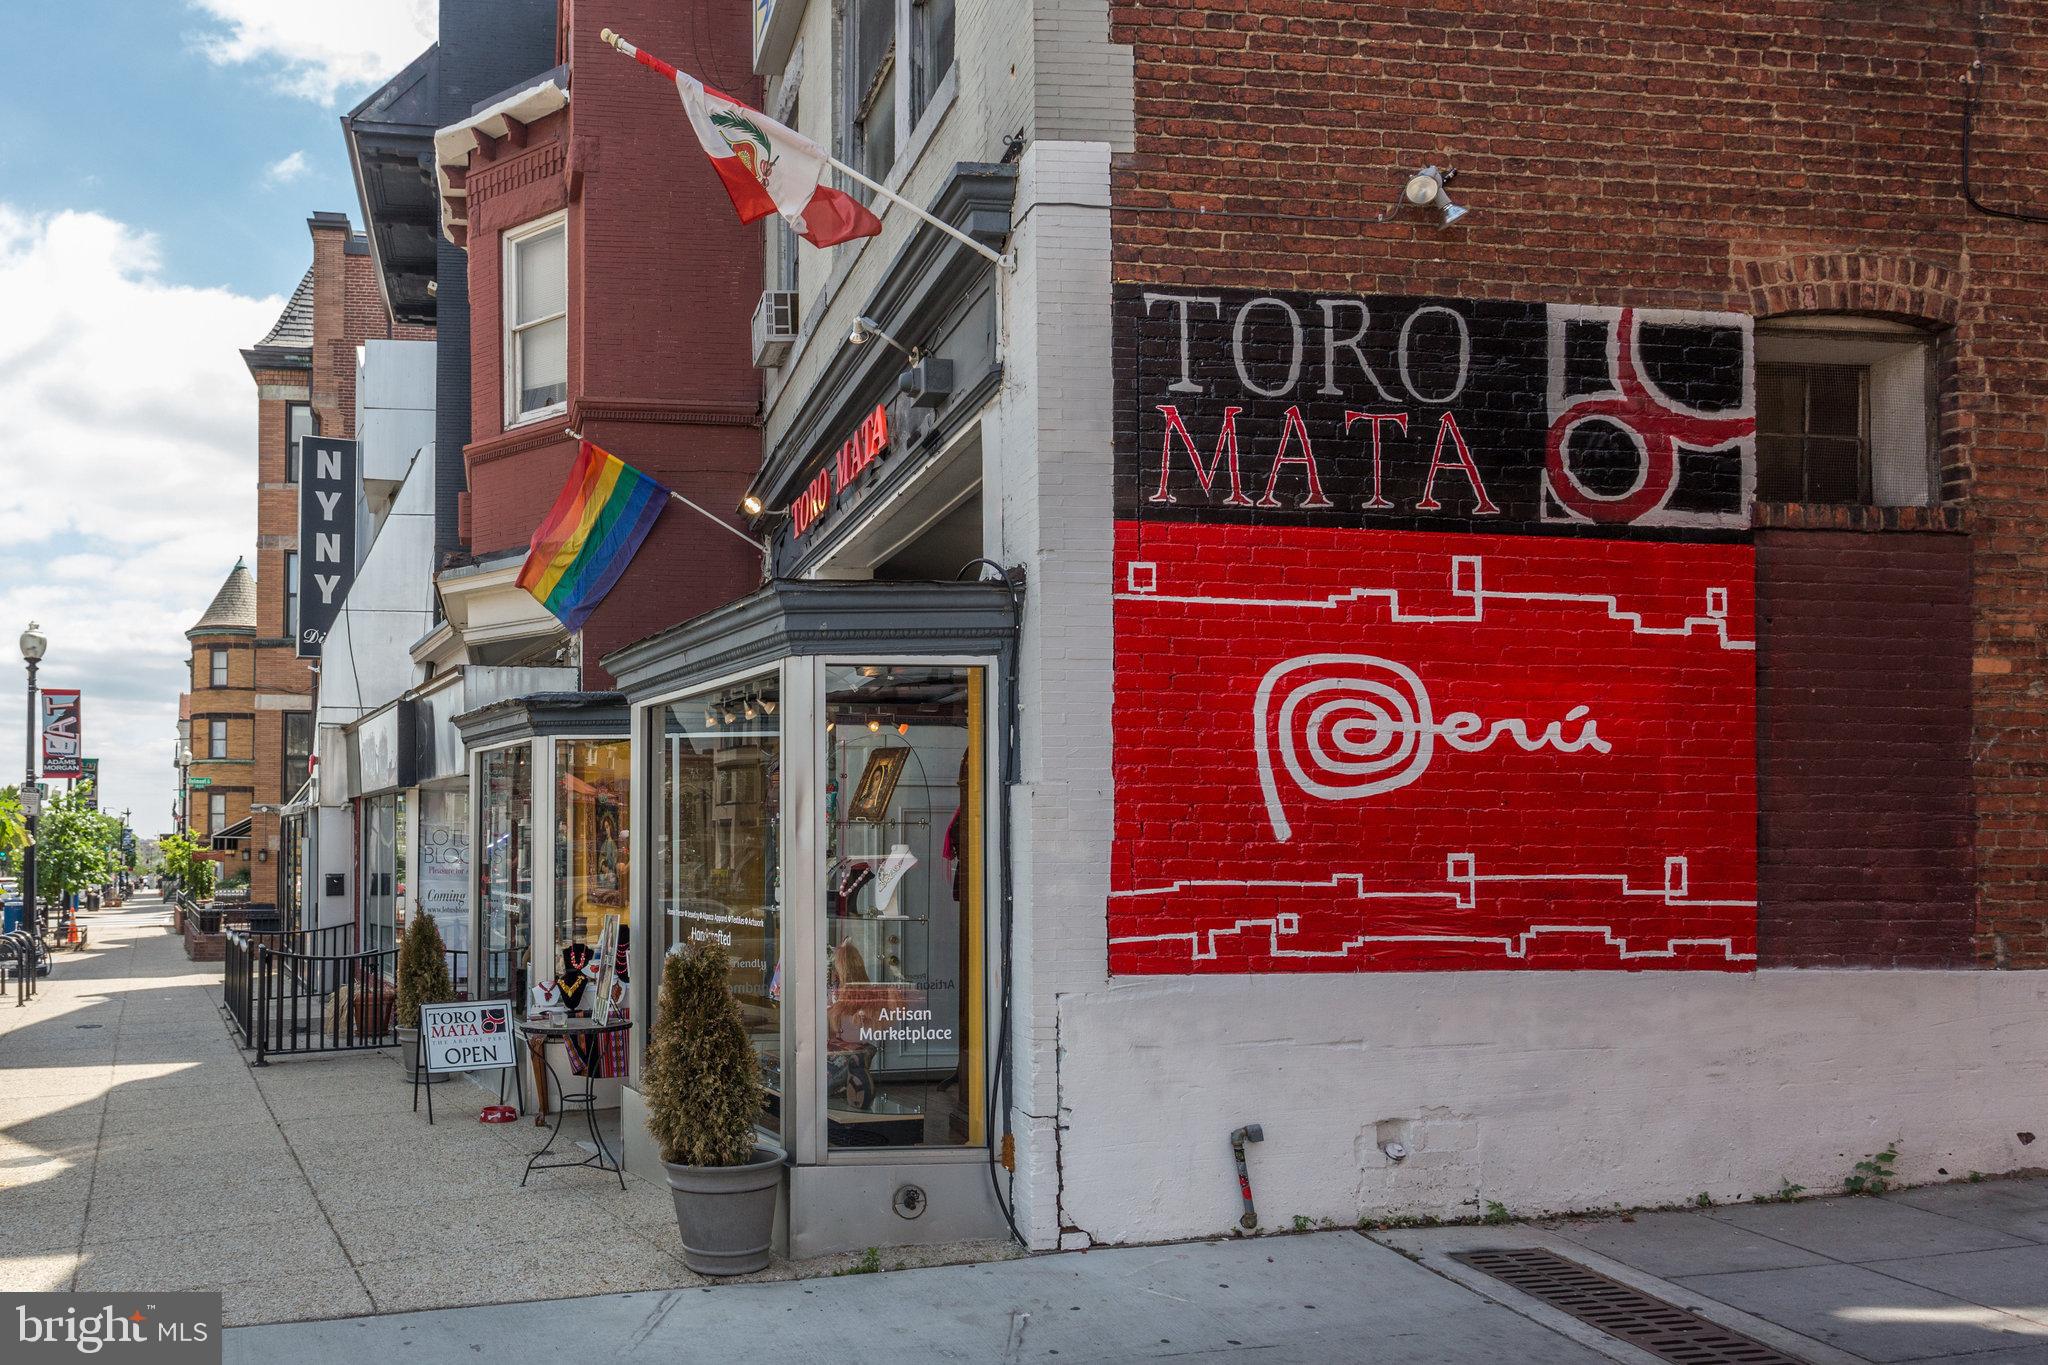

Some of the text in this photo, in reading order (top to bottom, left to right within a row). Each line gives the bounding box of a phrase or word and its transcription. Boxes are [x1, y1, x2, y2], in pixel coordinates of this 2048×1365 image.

[1143, 292, 1472, 403] TORO
[1148, 404, 1500, 516] MATA
[792, 402, 890, 540] TORO MATA
[1253, 652, 1613, 844] Perú
[425, 829, 470, 846] LOTU
[427, 889, 467, 906] Coming
[428, 1011, 477, 1025] TORO
[878, 1006, 932, 1021] Artisan
[431, 1023, 480, 1038] MATA
[859, 1026, 952, 1044] Marketplace
[445, 1045, 498, 1064] OPEN
